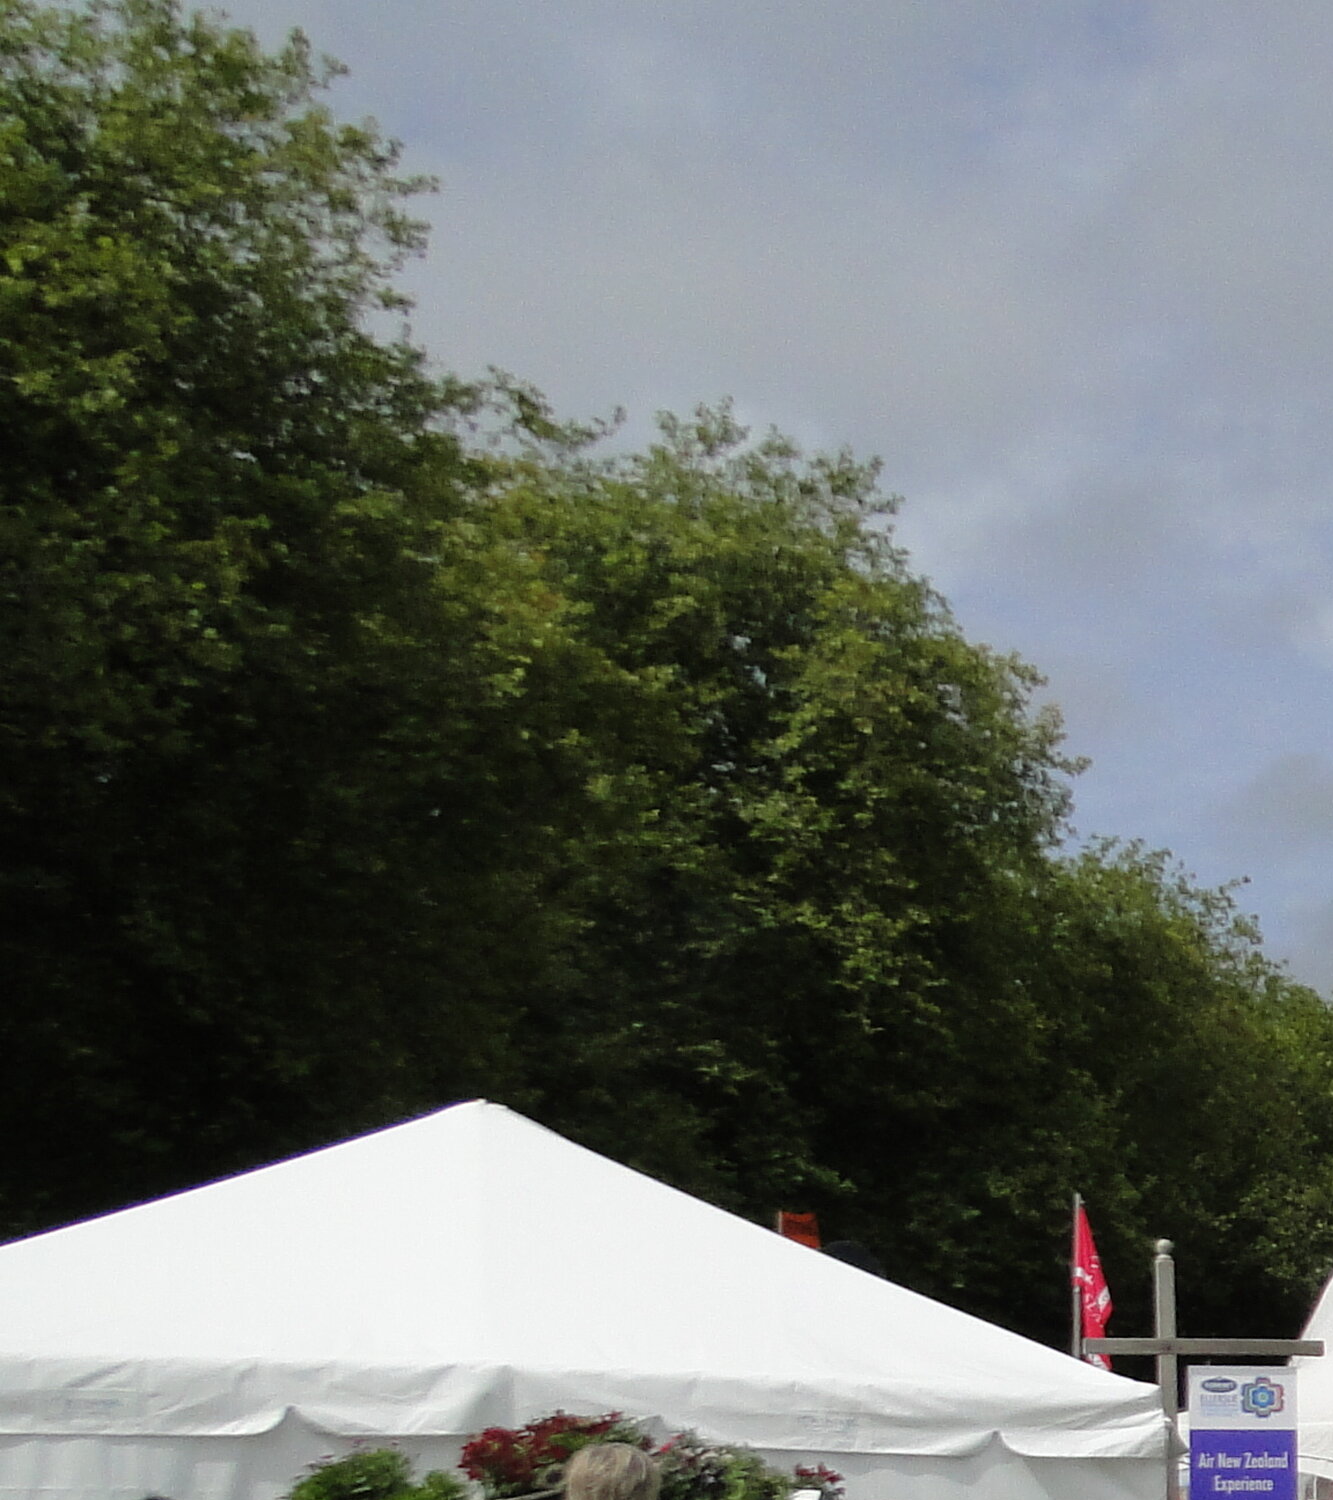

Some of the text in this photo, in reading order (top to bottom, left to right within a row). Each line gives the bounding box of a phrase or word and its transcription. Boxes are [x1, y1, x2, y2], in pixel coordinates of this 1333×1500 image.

[1199, 1451, 1288, 1468] Air New Zealand
[1214, 1475, 1274, 1494] Experience
